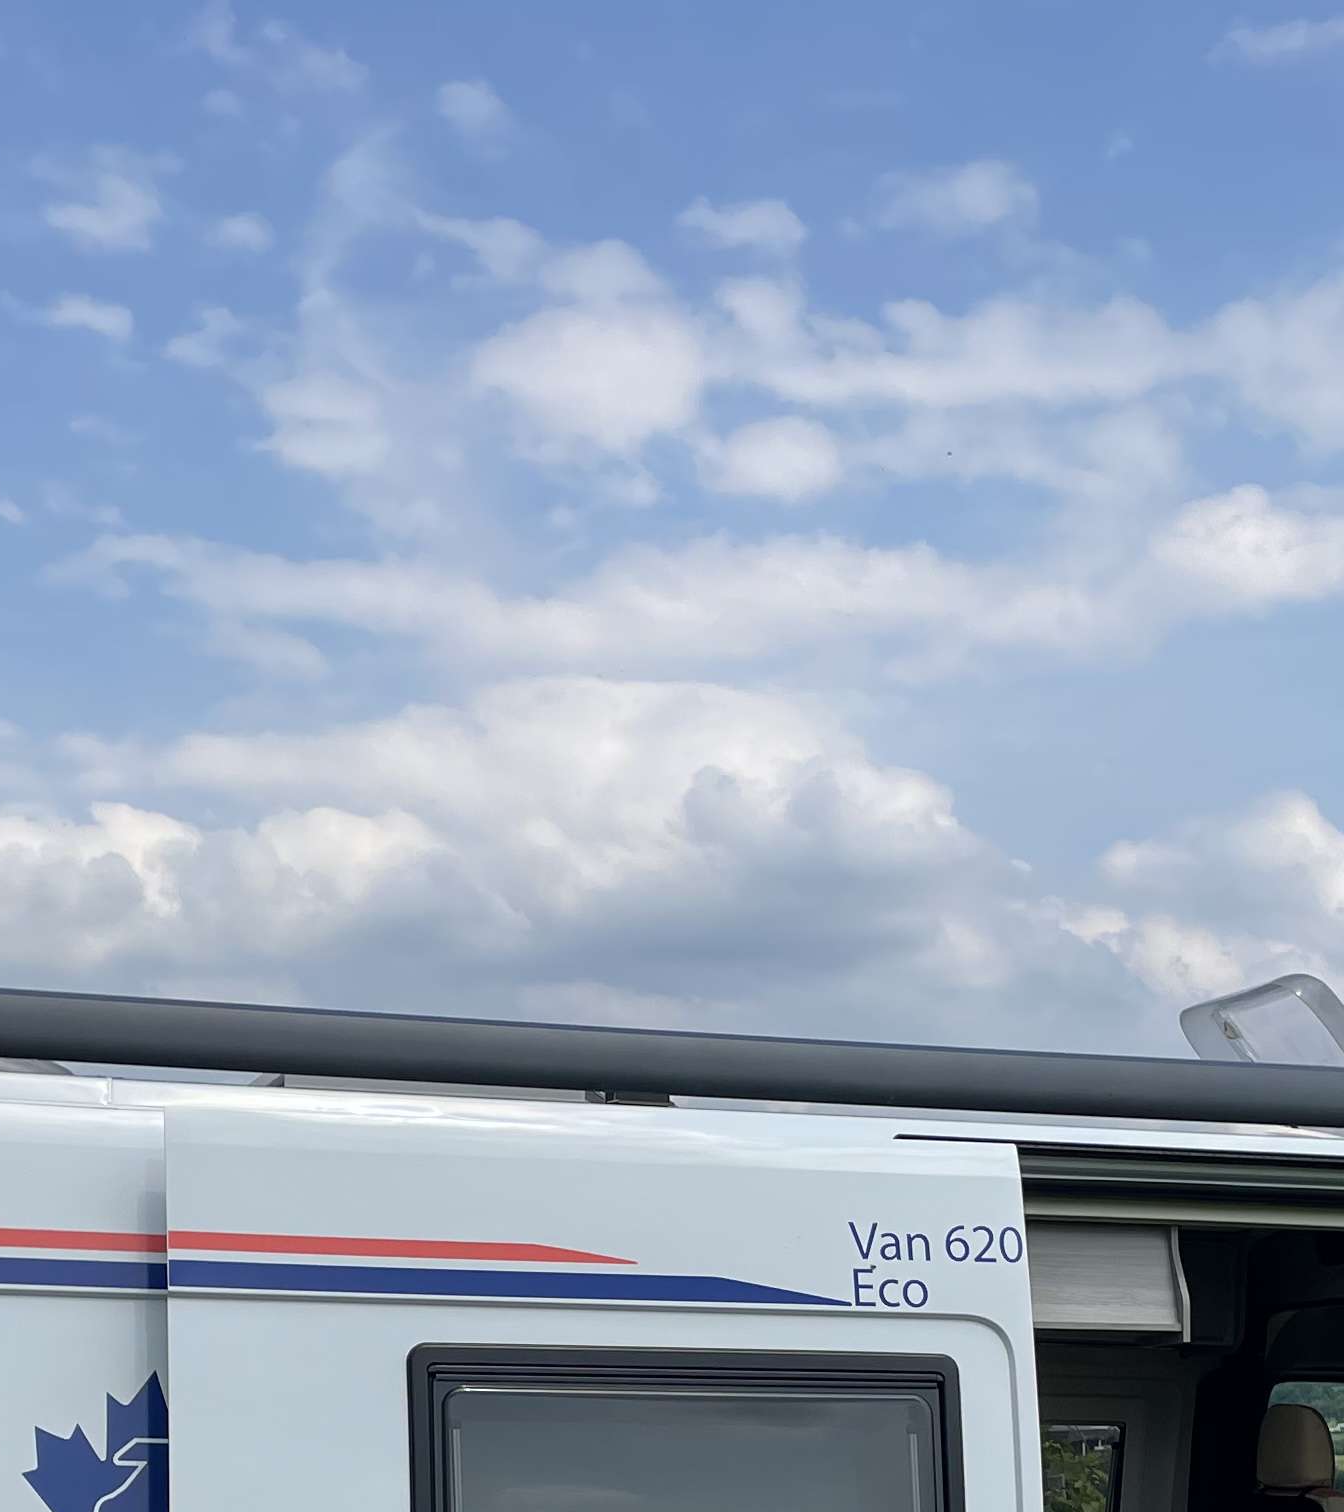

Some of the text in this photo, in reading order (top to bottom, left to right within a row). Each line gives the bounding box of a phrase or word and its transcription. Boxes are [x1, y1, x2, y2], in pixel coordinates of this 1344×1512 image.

[848, 1221, 1023, 1264] Van 620
[852, 1265, 929, 1308] Eco
